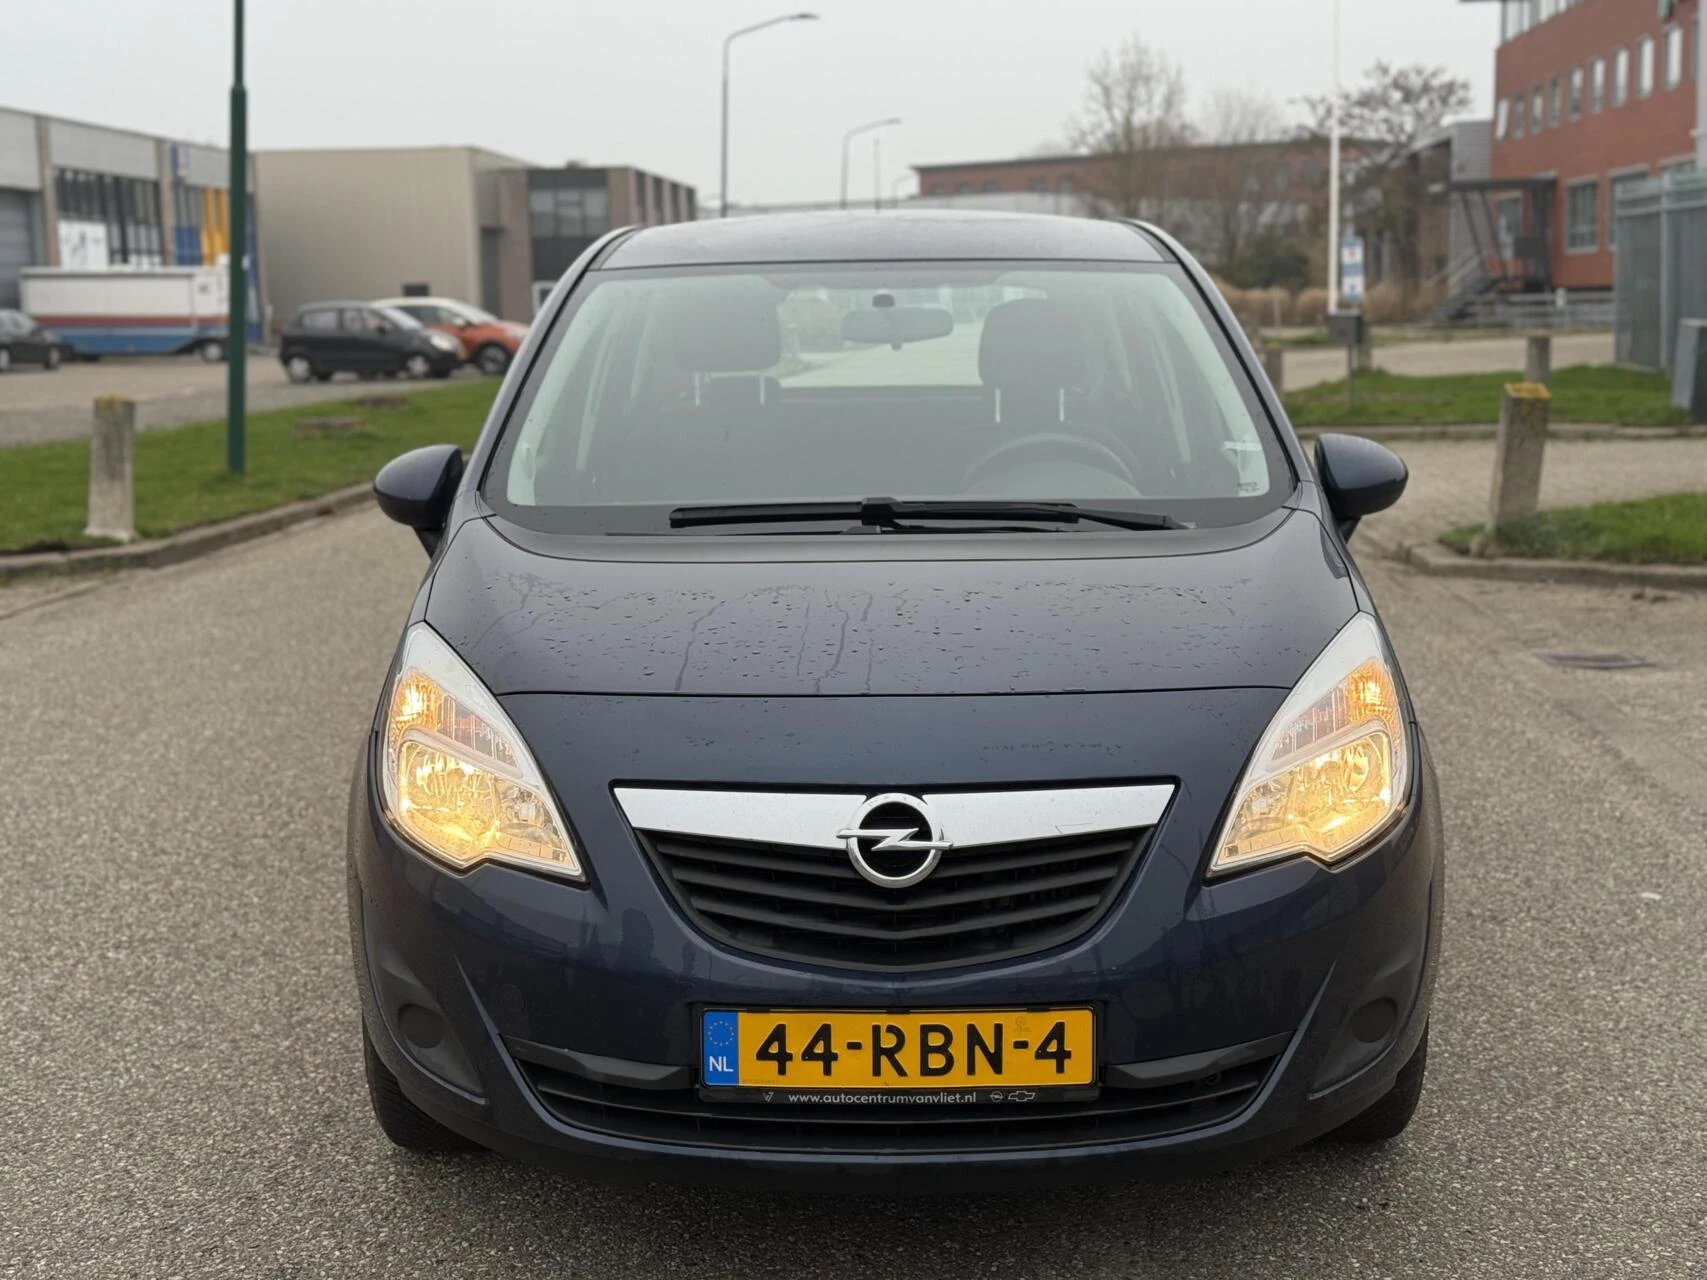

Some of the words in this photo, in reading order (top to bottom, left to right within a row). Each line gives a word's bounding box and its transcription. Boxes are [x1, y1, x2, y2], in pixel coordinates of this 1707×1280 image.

[755, 1021, 1072, 1077] 44-RBN-4
[709, 1055, 734, 1072] NL
[788, 1091, 977, 1103] www.autocentrumvanvliet.nl
